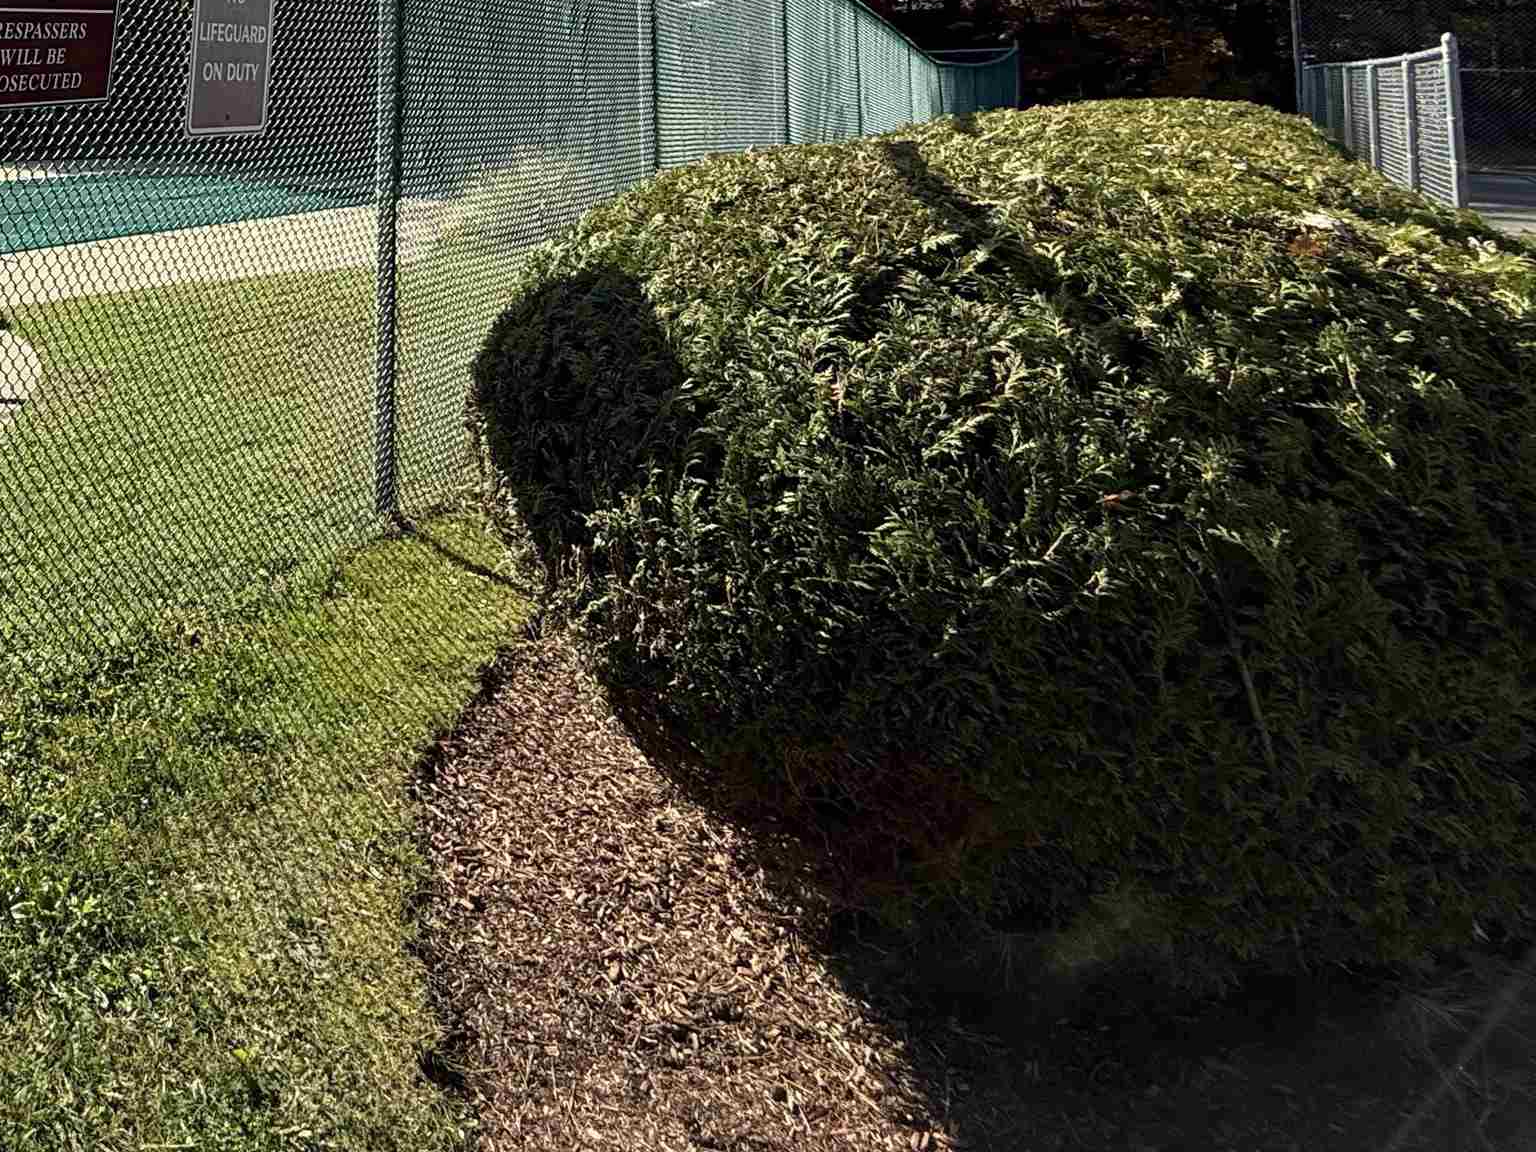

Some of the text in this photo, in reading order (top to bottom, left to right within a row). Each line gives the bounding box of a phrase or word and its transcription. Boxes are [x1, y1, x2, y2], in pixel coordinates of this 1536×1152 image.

[199, 21, 267, 44] LIFEGUARD
[0, 47, 67, 66] WILL BE
[202, 62, 260, 82] ON DUTY
